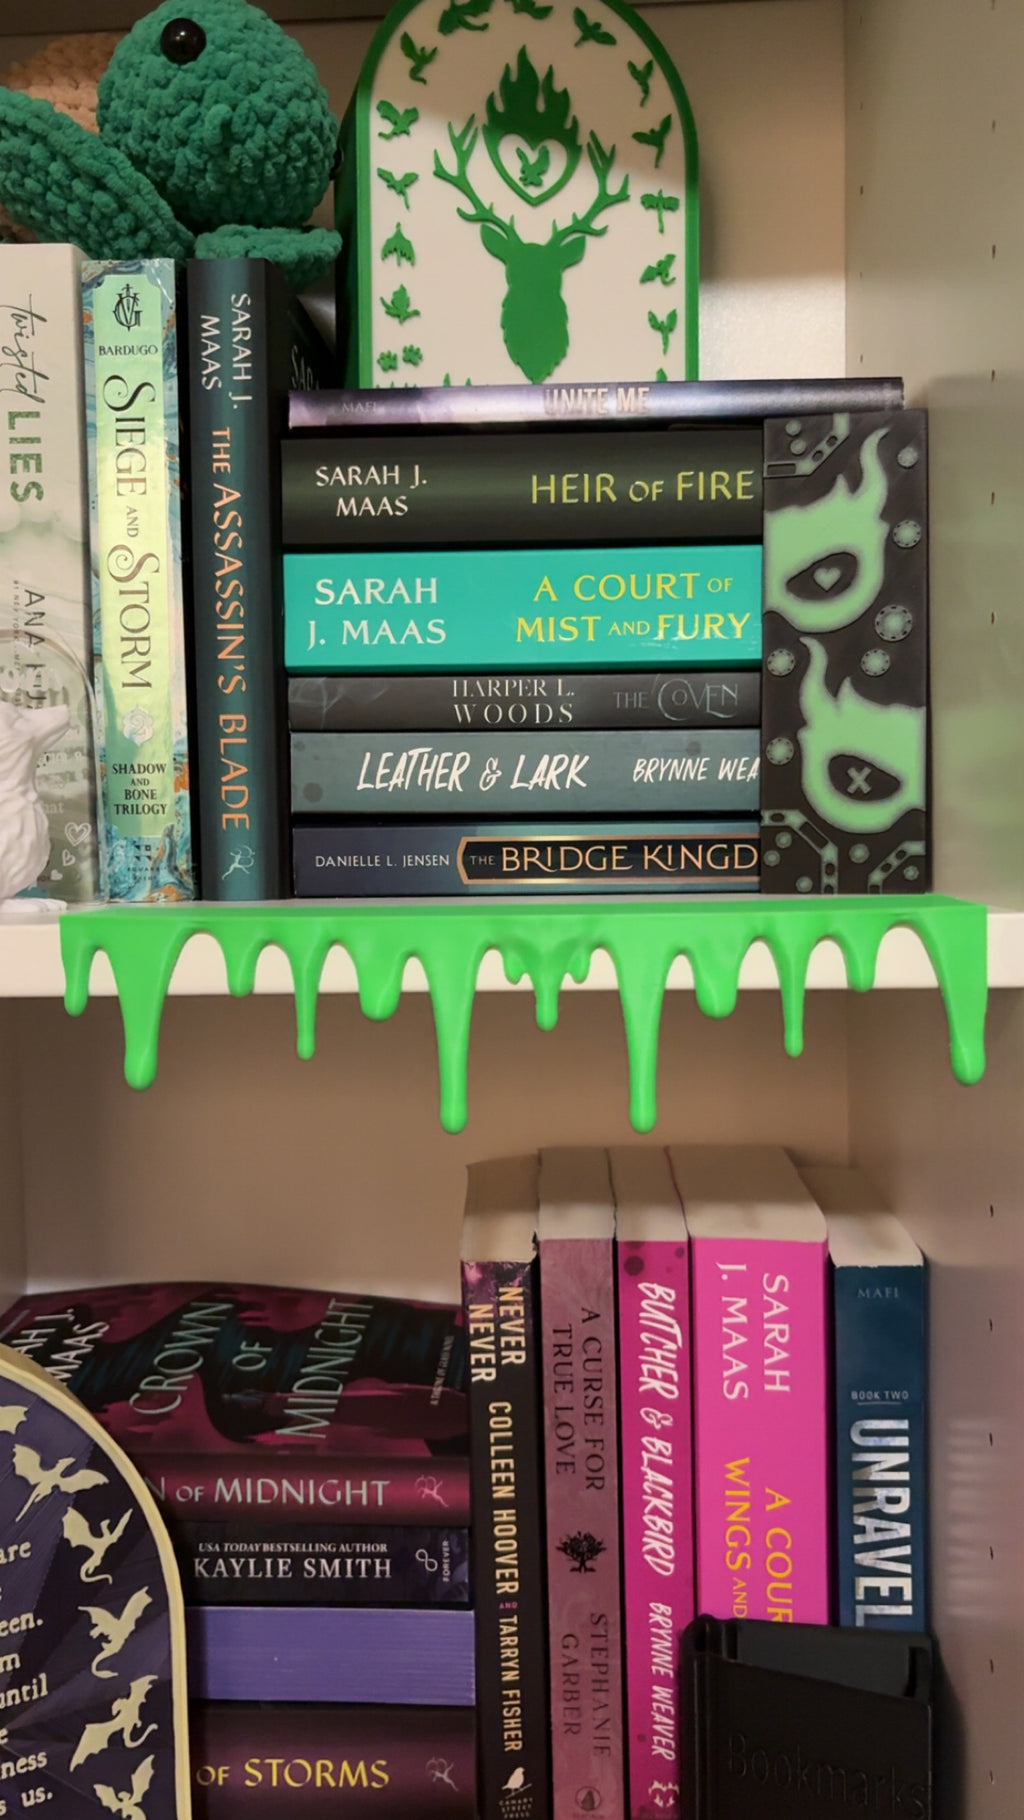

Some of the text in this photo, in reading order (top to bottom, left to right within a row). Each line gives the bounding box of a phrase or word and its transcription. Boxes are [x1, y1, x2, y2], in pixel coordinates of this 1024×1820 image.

[98, 345, 158, 356] BARDUGO
[200, 315, 222, 390] MAAS
[229, 293, 252, 409] SARAH J.
[0, 294, 49, 502] twisted LIES
[544, 387, 649, 415] UNITE ME
[315, 465, 427, 489] SARAH J.
[531, 470, 755, 504] HEIR OF FIRE
[336, 496, 409, 517] MAAS
[103, 375, 160, 688] SIEGE AND STORM
[314, 577, 437, 605] SARAH
[533, 572, 733, 602] A COURT OF
[212, 427, 249, 830] THE ASSASSIN'S BLADE
[308, 618, 447, 651] J. MAAS
[516, 612, 751, 642] MIST AND FURY
[453, 678, 575, 697] HARPER L.
[613, 677, 739, 721] THE COVEN
[453, 703, 573, 724] WOODS
[112, 763, 168, 775] SHADOW
[130, 778, 150, 786] AND
[357, 747, 590, 792] LEATHER & LARK
[633, 757, 761, 783] BRYNNE WEA
[114, 803, 168, 815] TRILOGY
[124, 789, 157, 800] BONE
[315, 854, 450, 868] DANIELLE L. JENSEN
[469, 844, 758, 873] THE BRIDGE KINGD
[857, 1287, 899, 1299] MAFI
[498, 1286, 526, 1365] NEVER
[716, 1261, 749, 1400] J. MAAS
[763, 1273, 790, 1392] SARAH
[129, 1302, 234, 1415] CROWN
[232, 1340, 273, 1371] OF
[469, 1304, 497, 1383] NEVER
[275, 1297, 374, 1438] MIDNIGHT
[553, 1323, 576, 1475] TRUE LOVE
[581, 1307, 606, 1491] A CURSE FOR
[851, 1391, 909, 1400] BOOK TWO
[638, 1282, 683, 1577] BUTCHER & BLACKBIRD
[176, 1486, 204, 1502] OF
[214, 1477, 391, 1507] MIDNIGHT
[765, 1486, 791, 1512] A
[724, 1457, 751, 1619] WINGS AND
[850, 1419, 914, 1627] UNRAVEL
[198, 1543, 388, 1553] USA TODAY BESTSELLING AUTHOR
[442, 1541, 450, 1583] FOREVER
[194, 1558, 392, 1579] KAYLIE SMITH
[488, 1401, 524, 1752] COLLEEN HOOVER AND TARRYN FISHER
[561, 1633, 582, 1735] GARBER
[590, 1612, 612, 1758] STEPHANIE
[648, 1601, 676, 1761] BRYNNE WEAVER
[196, 1758, 390, 1788] OF STORMS
[728, 1733, 927, 1820] Bookmarks
[21, 1786, 53, 1807] us.
